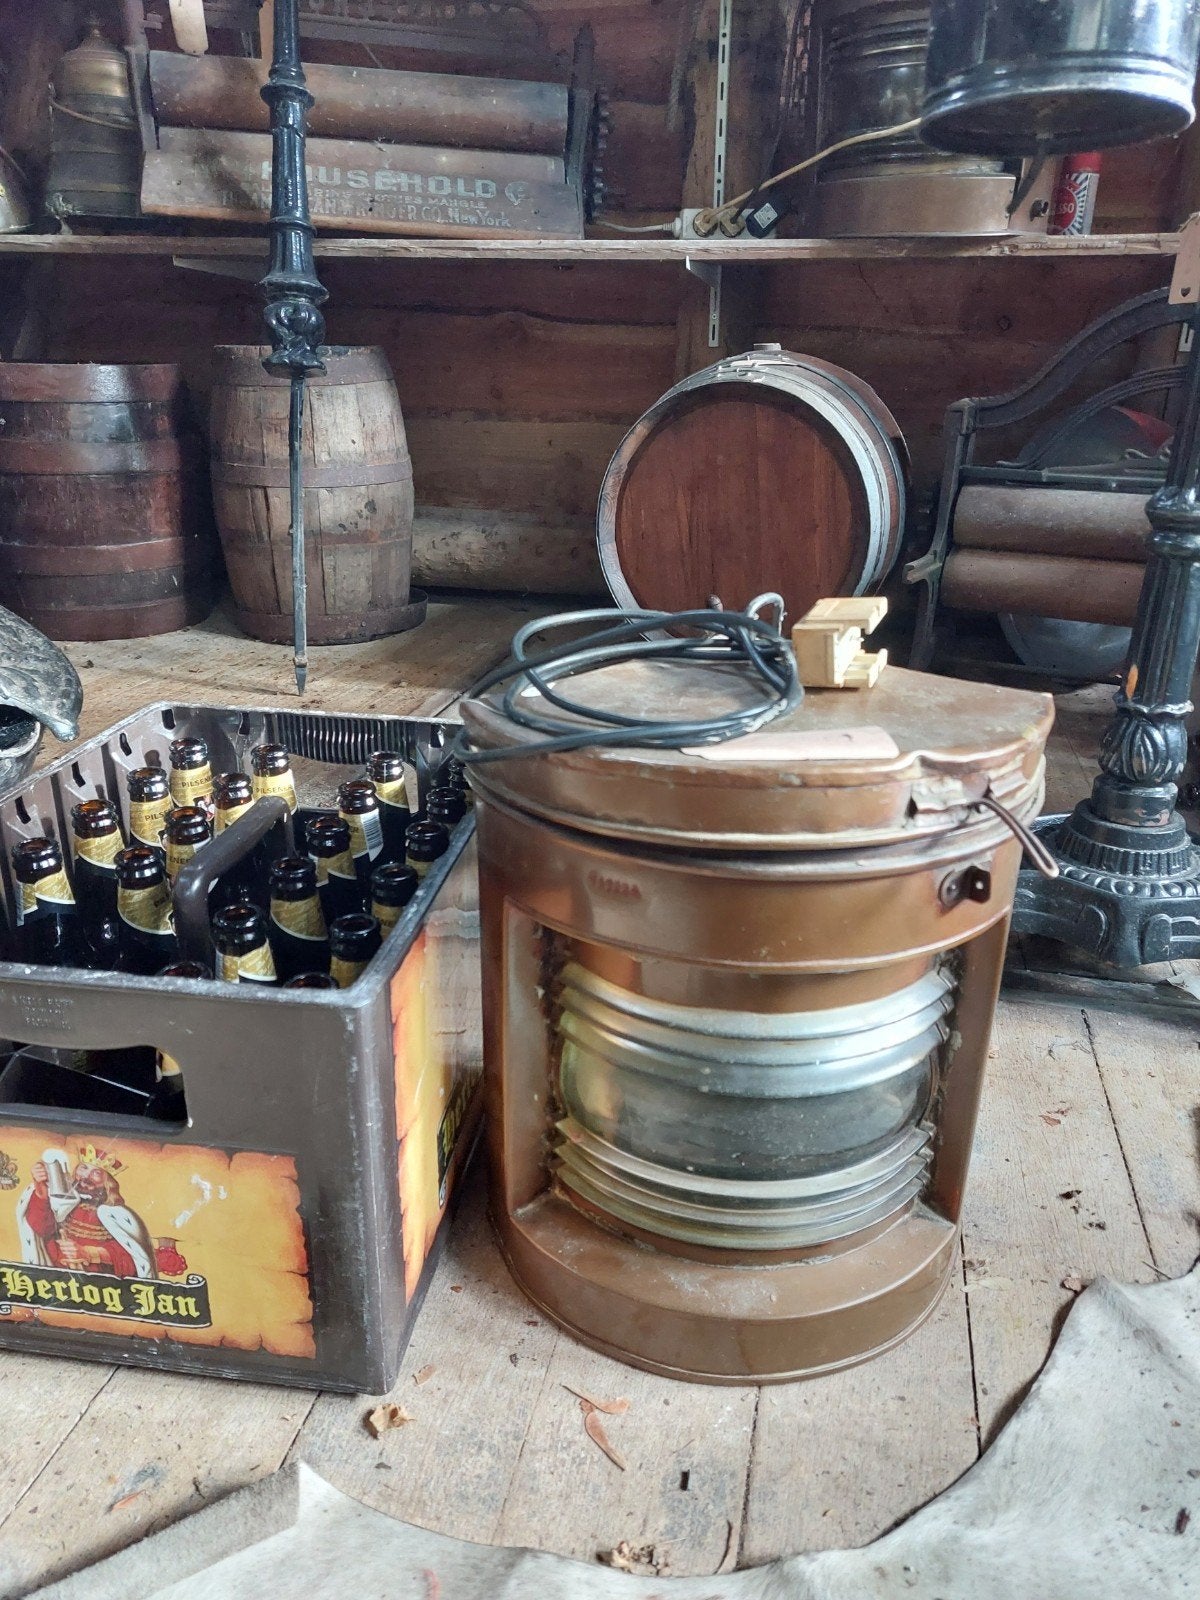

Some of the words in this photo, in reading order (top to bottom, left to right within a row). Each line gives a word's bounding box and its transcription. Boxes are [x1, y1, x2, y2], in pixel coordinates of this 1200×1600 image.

[261, 160, 497, 199] HUSEHOLD
[1, 1268, 125, 1313] Hertog
[131, 1283, 200, 1318] Jan
